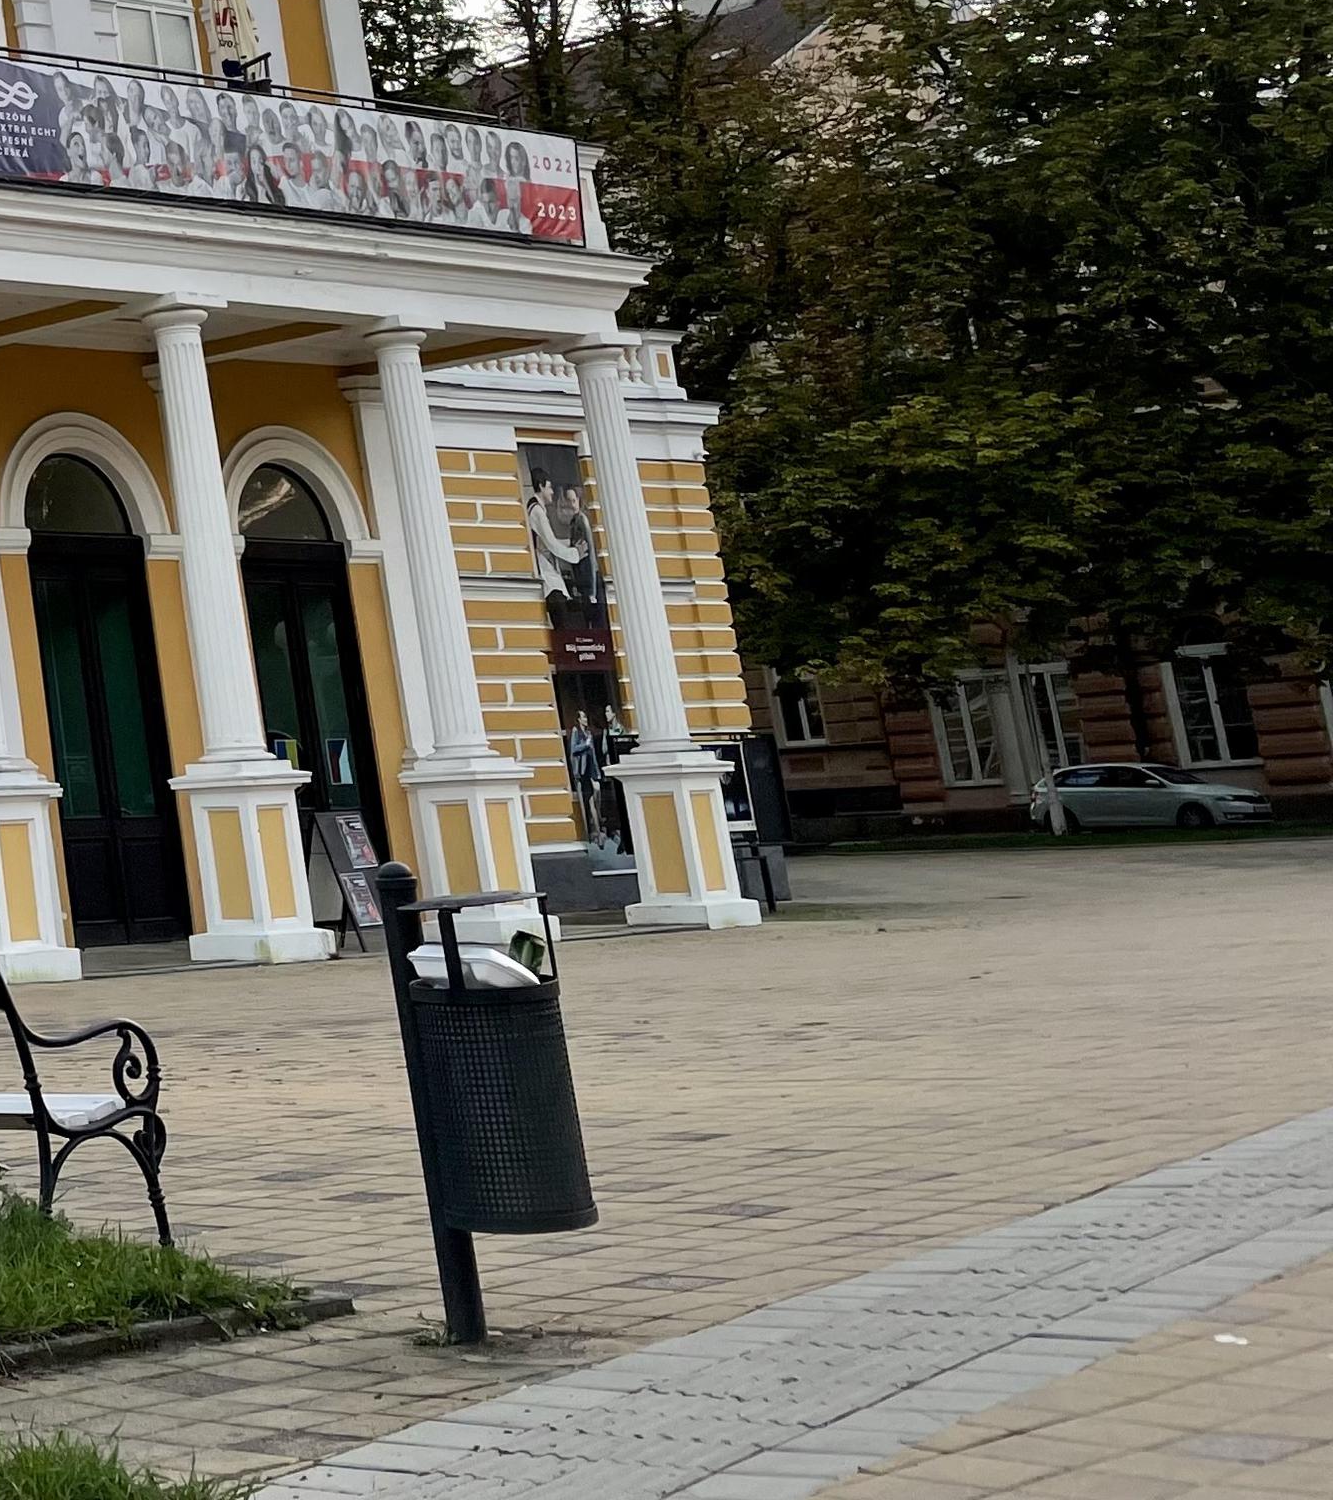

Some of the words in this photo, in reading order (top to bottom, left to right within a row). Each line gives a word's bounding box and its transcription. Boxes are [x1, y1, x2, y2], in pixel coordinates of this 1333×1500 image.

[31, 127, 57, 138] ECHT
[533, 155, 572, 173] 2022
[537, 202, 577, 221] 2023
